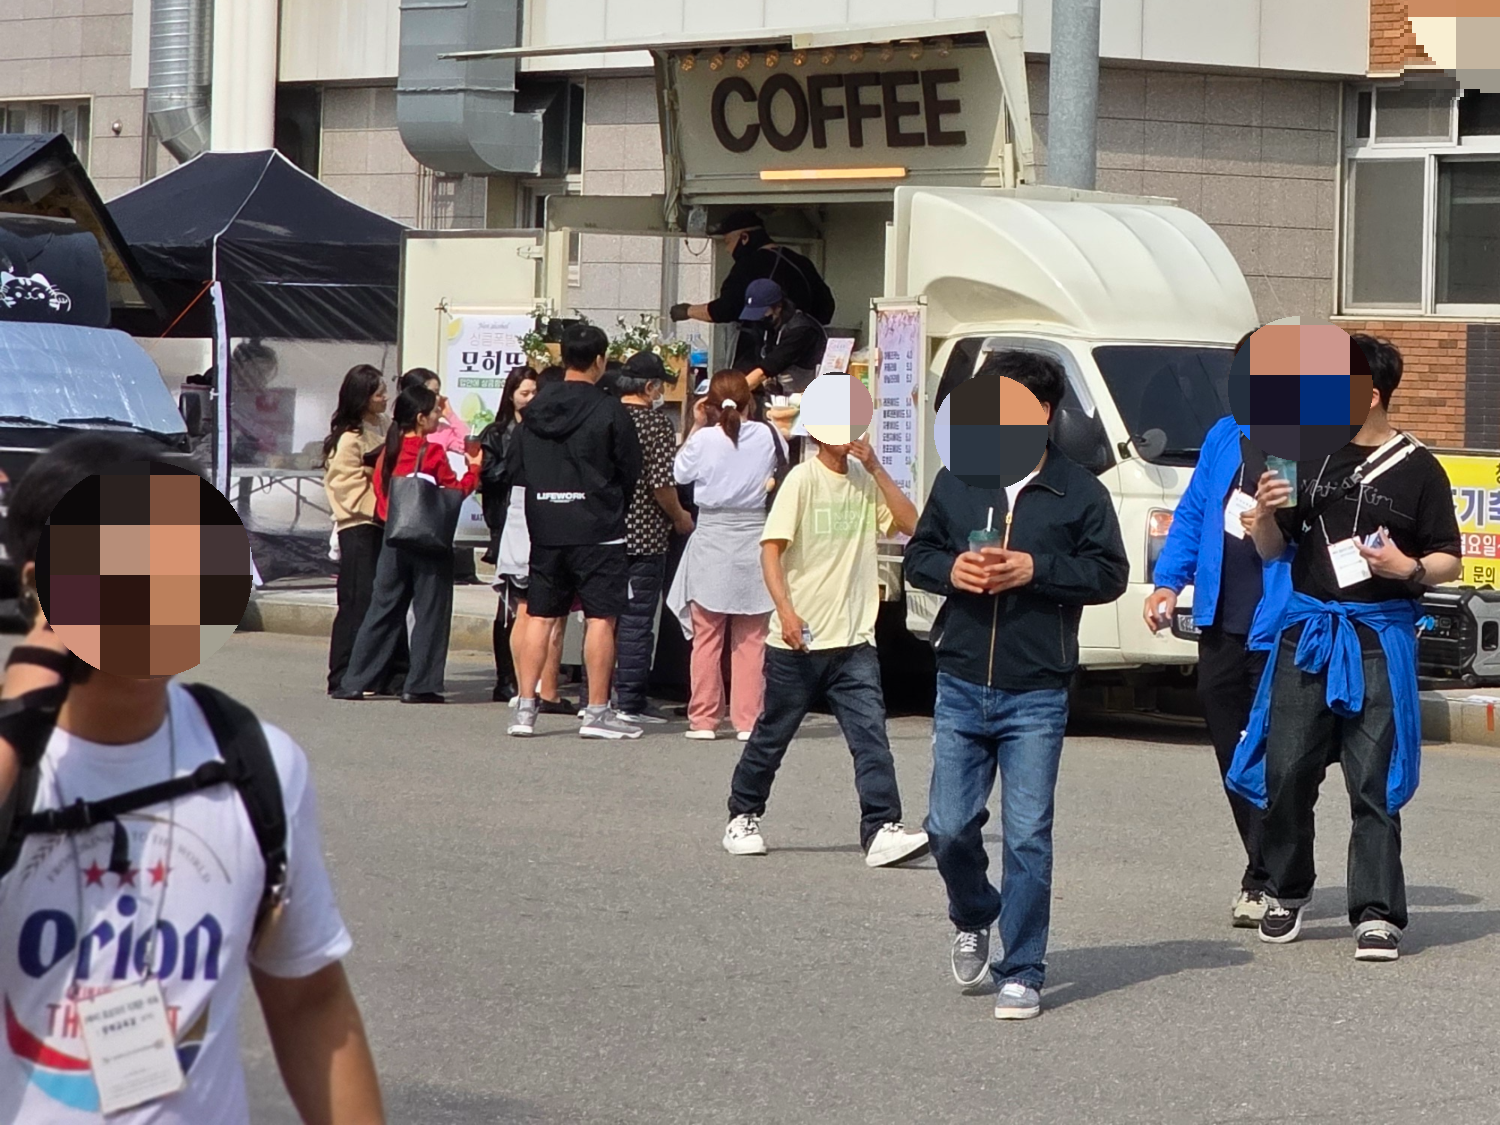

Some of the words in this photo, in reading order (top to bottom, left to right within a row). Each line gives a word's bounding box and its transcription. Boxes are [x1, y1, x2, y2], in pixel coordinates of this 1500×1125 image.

[711, 68, 967, 153] COFFEE
[536, 492, 586, 501] LIFEWORK
[1473, 566, 1496, 584] 문의
[47, 1003, 80, 1039] TH
